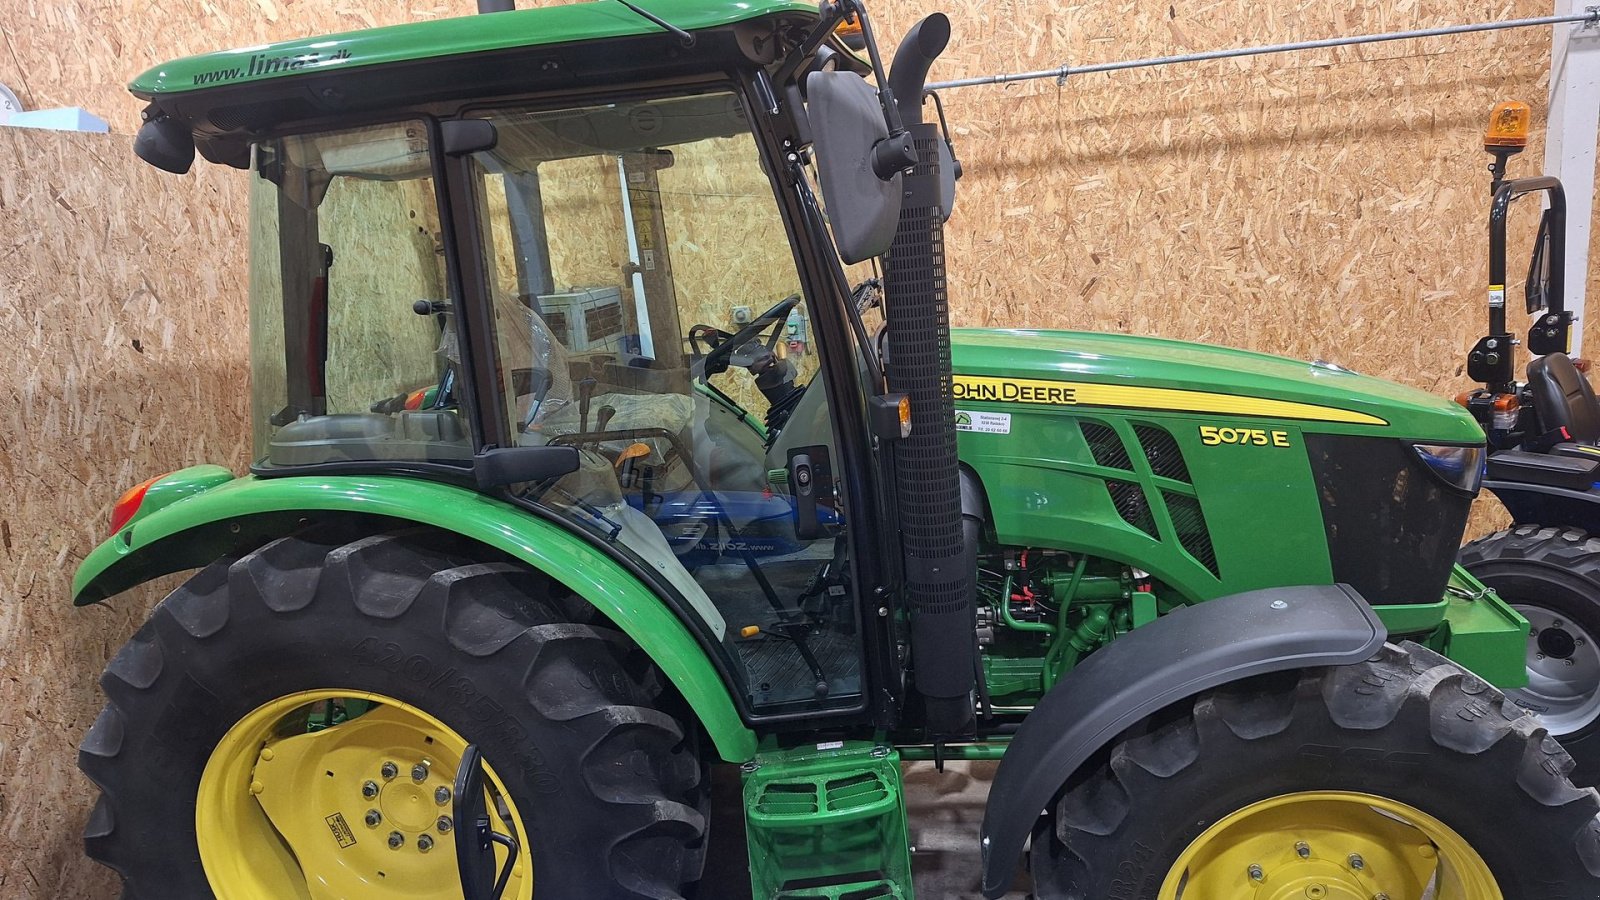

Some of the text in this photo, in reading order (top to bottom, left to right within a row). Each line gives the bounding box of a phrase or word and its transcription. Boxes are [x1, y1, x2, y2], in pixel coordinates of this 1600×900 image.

[193, 49, 352, 85] www.limasdk
[5, 100, 12, 110] 2
[953, 382, 1077, 402] OHN DEERE
[1199, 425, 1291, 448] 5075 E
